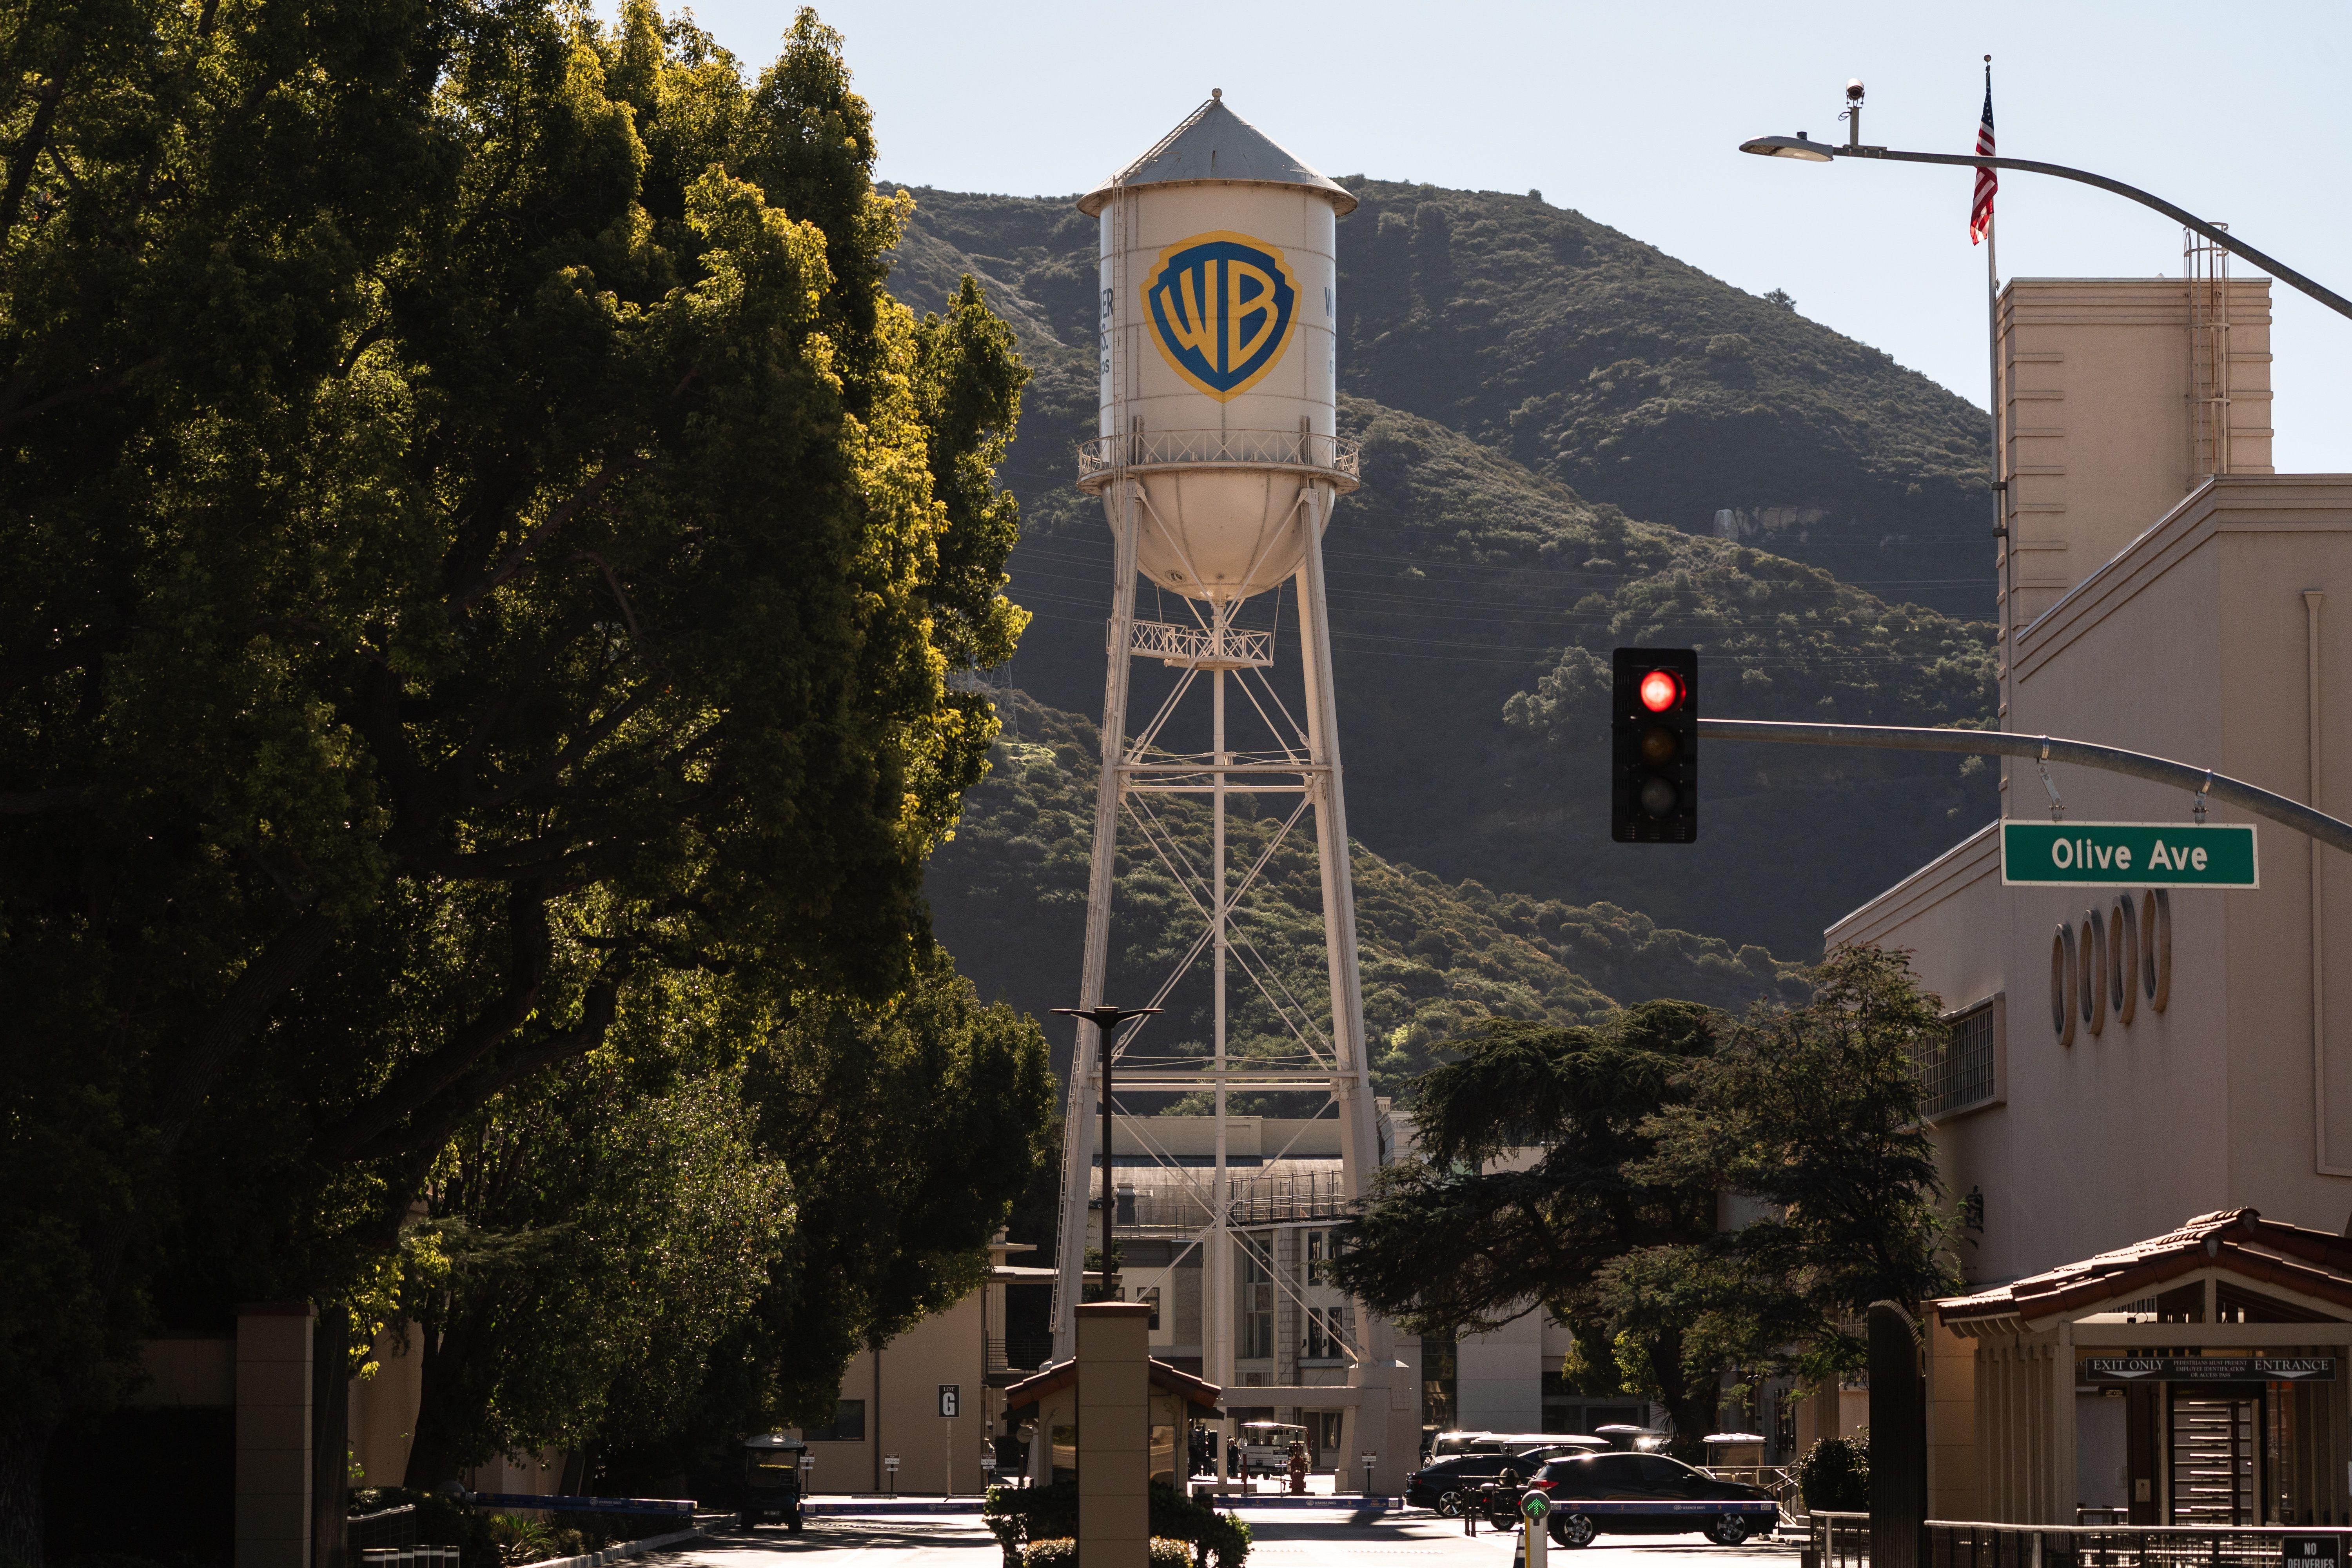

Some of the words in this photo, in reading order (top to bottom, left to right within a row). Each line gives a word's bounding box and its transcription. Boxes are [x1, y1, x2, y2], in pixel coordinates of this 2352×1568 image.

[1159, 259, 1279, 374] WB
[2052, 838, 2132, 869] Olive
[2148, 840, 2208, 871] Ave
[2094, 1360, 2125, 1370] EXIT
[2129, 1360, 2164, 1370] ONLY
[2255, 1360, 2328, 1370] ENTRANCE
[943, 1392, 955, 1416] G
[2304, 1542, 2316, 1555] NO
[2288, 1558, 2334, 1568] DELIVERIES
